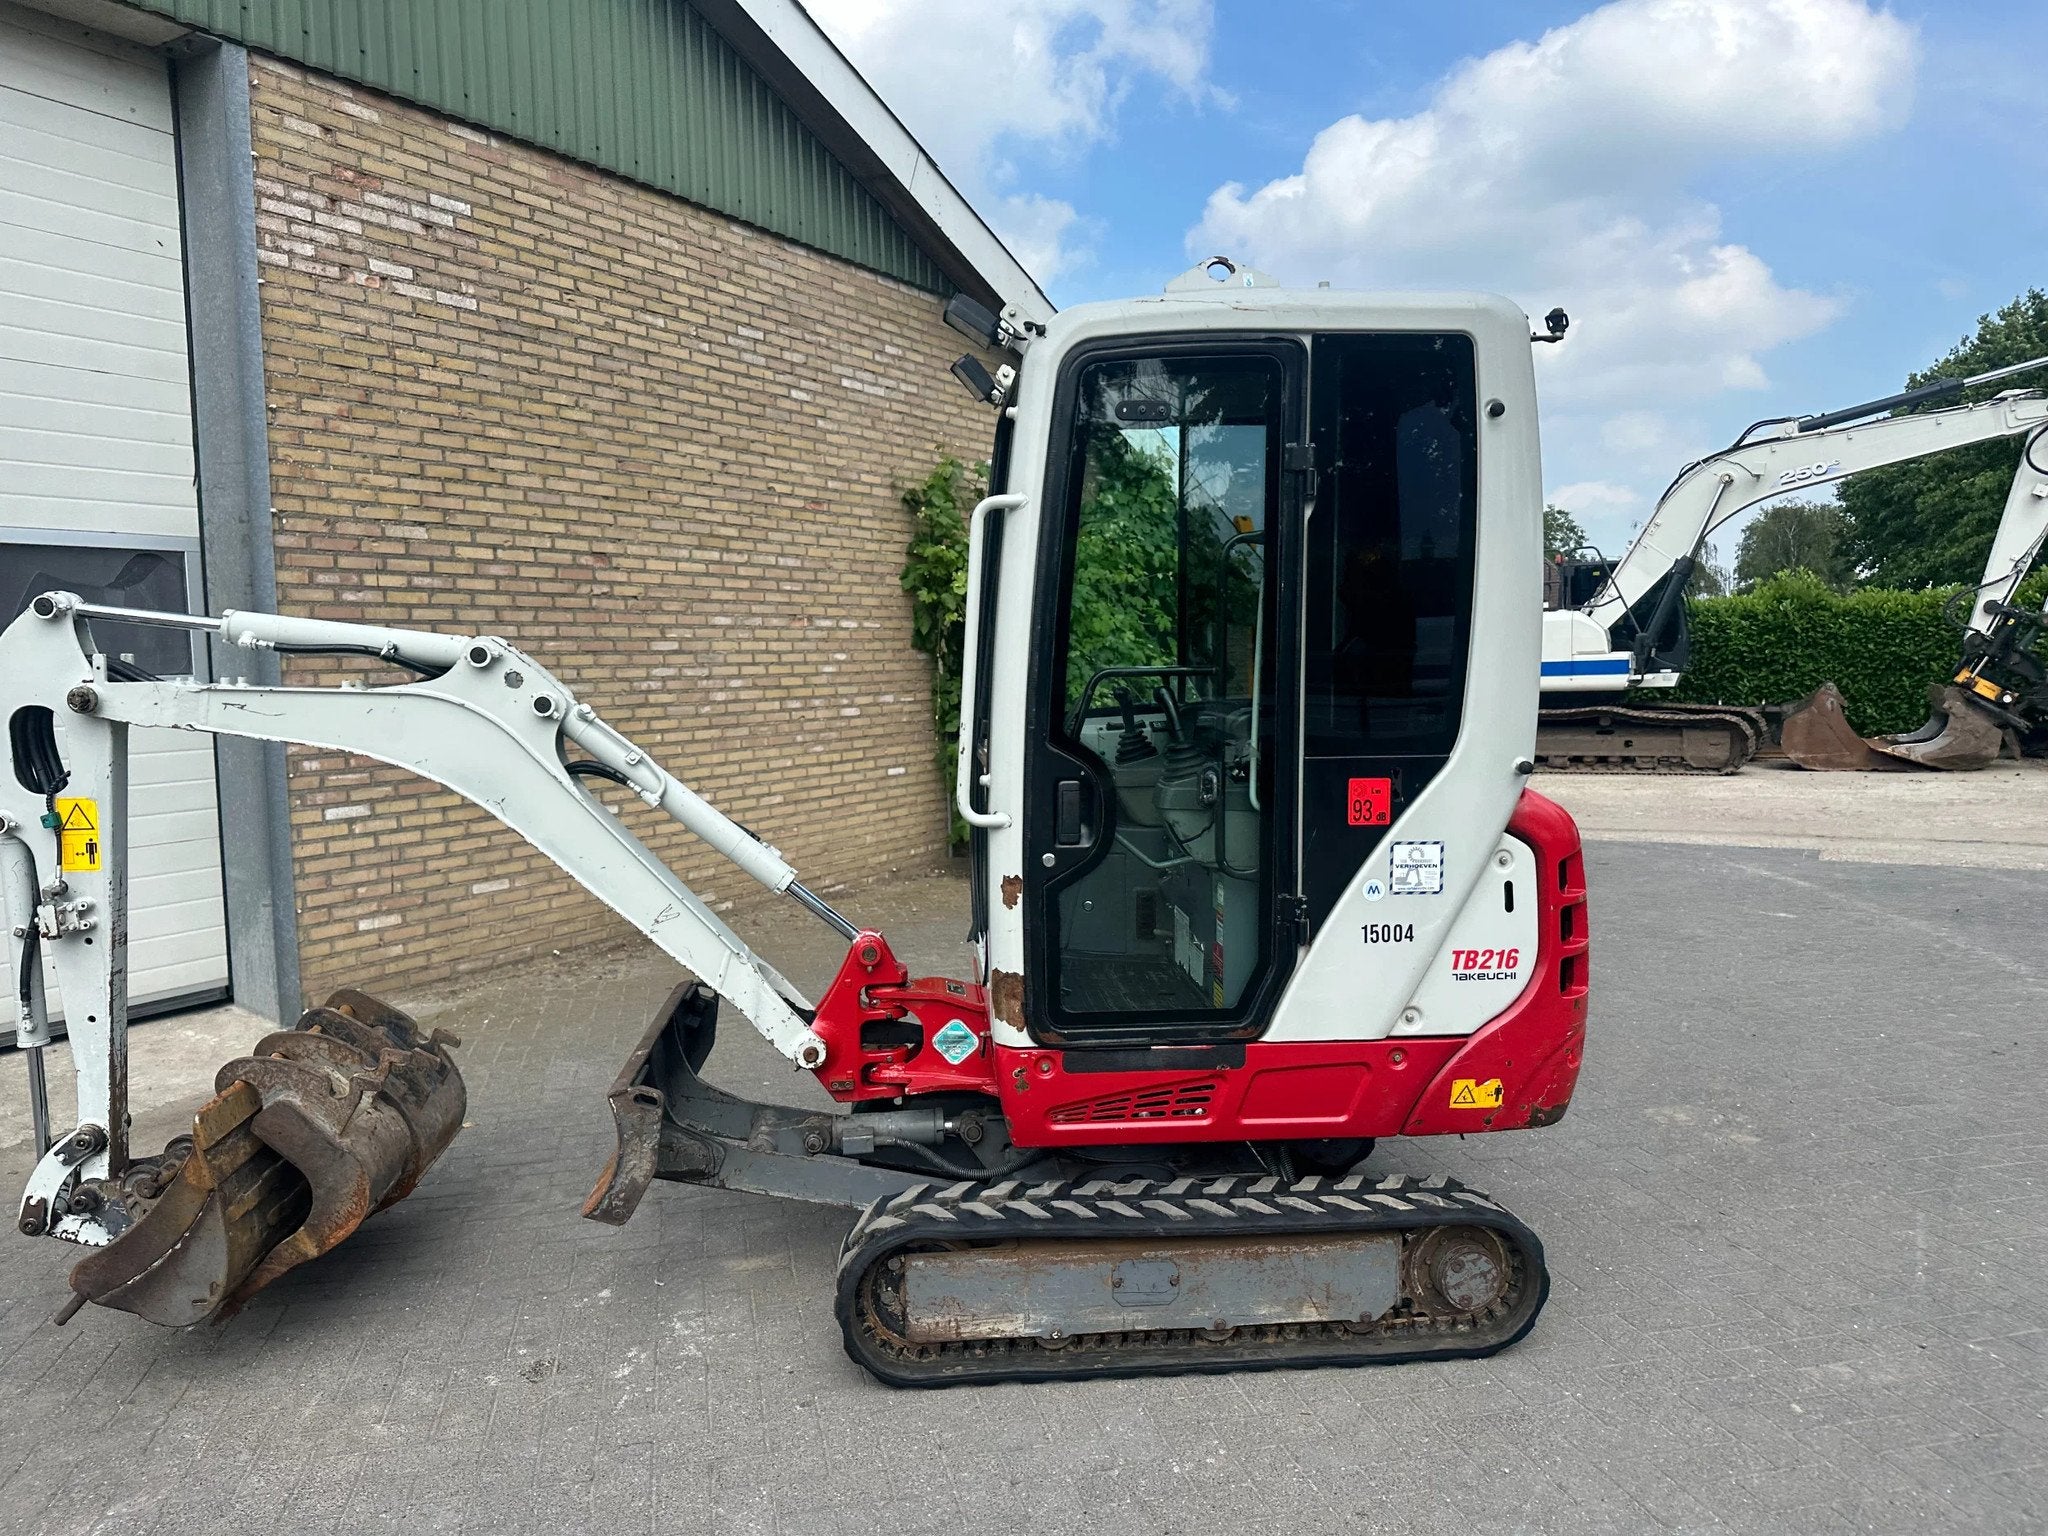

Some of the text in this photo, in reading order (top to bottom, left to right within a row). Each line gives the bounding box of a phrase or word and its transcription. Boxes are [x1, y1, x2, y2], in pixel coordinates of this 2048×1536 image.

[1780, 461, 1828, 485] 250
[1353, 799, 1387, 821] 93 dB
[1361, 924, 1414, 943] 15004
[1452, 949, 1519, 970] TB216
